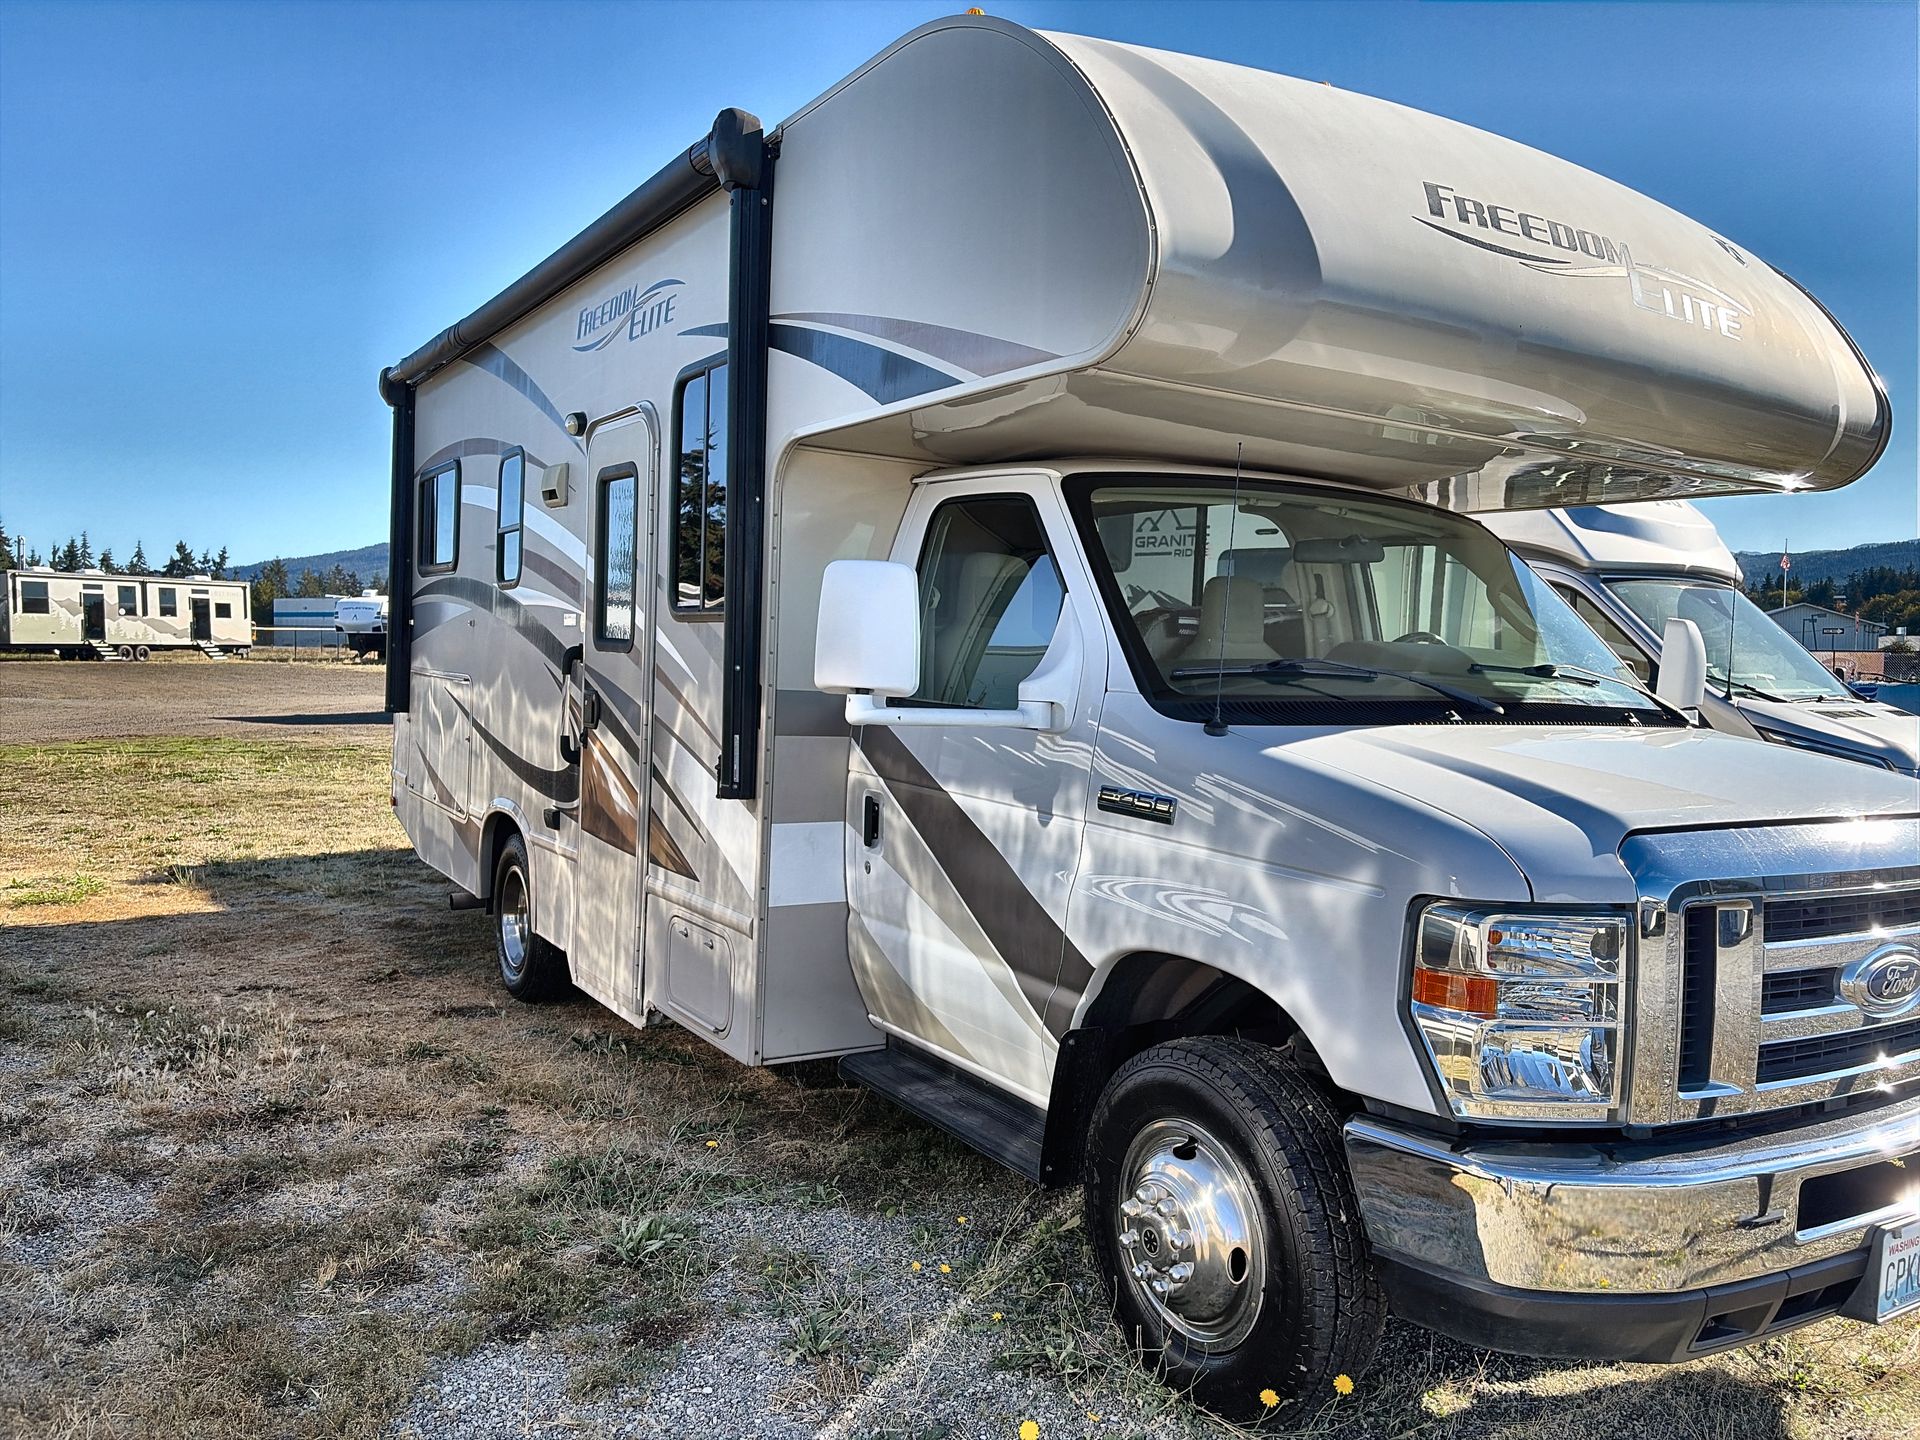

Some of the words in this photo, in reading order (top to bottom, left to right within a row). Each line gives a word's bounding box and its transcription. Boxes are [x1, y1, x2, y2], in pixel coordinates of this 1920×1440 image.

[1422, 180, 1634, 265] FREEDOM
[577, 284, 638, 340] FREEDOM
[628, 294, 677, 341] ELITE
[1629, 268, 1744, 341] ELITE
[1135, 534, 1210, 548] GRANIT
[1882, 965, 1917, 996] Ford
[1884, 1252, 1920, 1301] CPK
